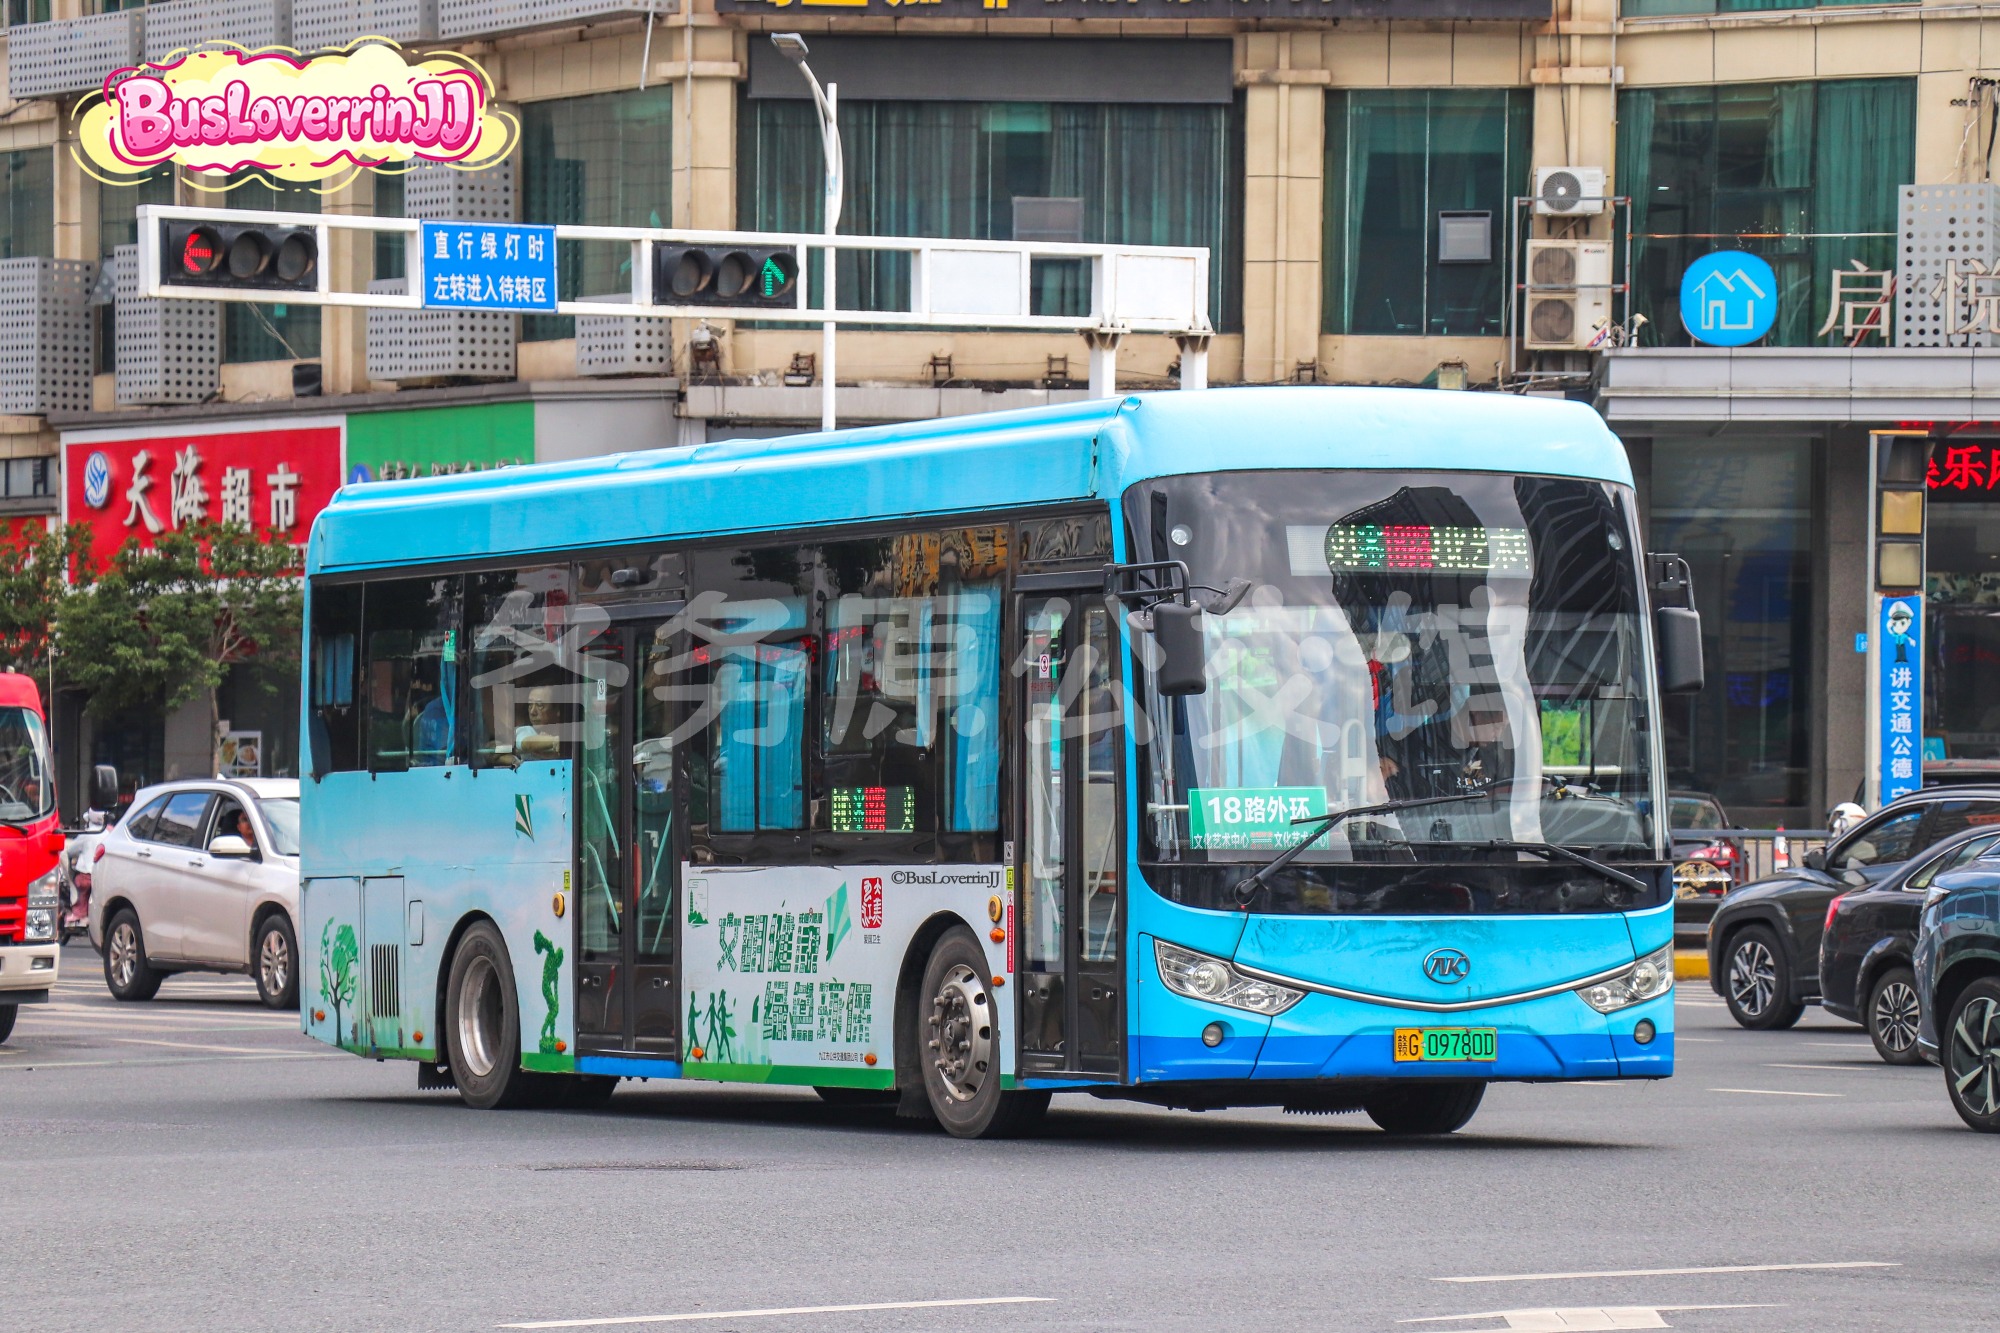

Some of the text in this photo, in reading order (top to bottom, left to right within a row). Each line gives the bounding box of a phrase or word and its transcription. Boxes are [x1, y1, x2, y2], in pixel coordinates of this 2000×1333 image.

[432, 229, 547, 263] 直行绿灯时
[432, 273, 548, 305] 左转进入待转区
[122, 443, 303, 534] 天海超市
[1889, 667, 1913, 779] 讲交通公德
[1206, 795, 1311, 825] 18路外环
[1193, 832, 1250, 849] 文化艺术中心
